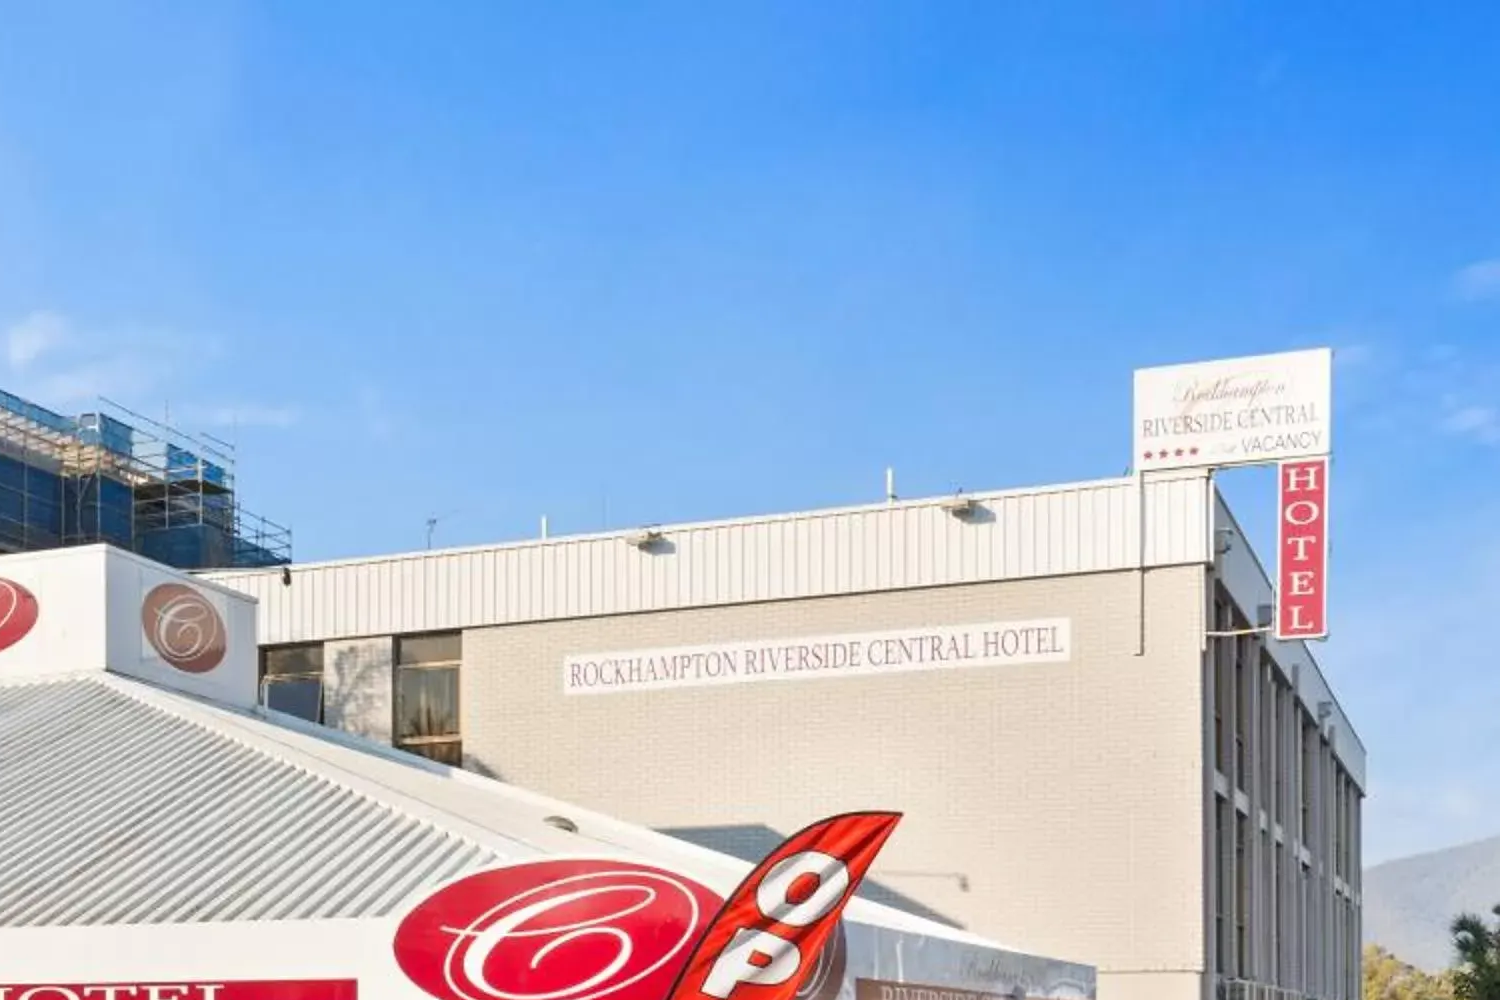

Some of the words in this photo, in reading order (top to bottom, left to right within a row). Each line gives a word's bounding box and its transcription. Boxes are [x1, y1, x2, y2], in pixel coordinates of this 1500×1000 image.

[1142, 410, 1234, 438] RIVERSIDE
[1237, 402, 1321, 430] CENTRAL
[1241, 430, 1322, 455] VACANCY
[1285, 466, 1320, 630] HOTEL
[569, 650, 738, 688] ROCKHAMPTON
[744, 641, 862, 676] RIVERSIDE
[867, 633, 977, 667] CENTRAL
[982, 626, 1065, 658] HOTEL
